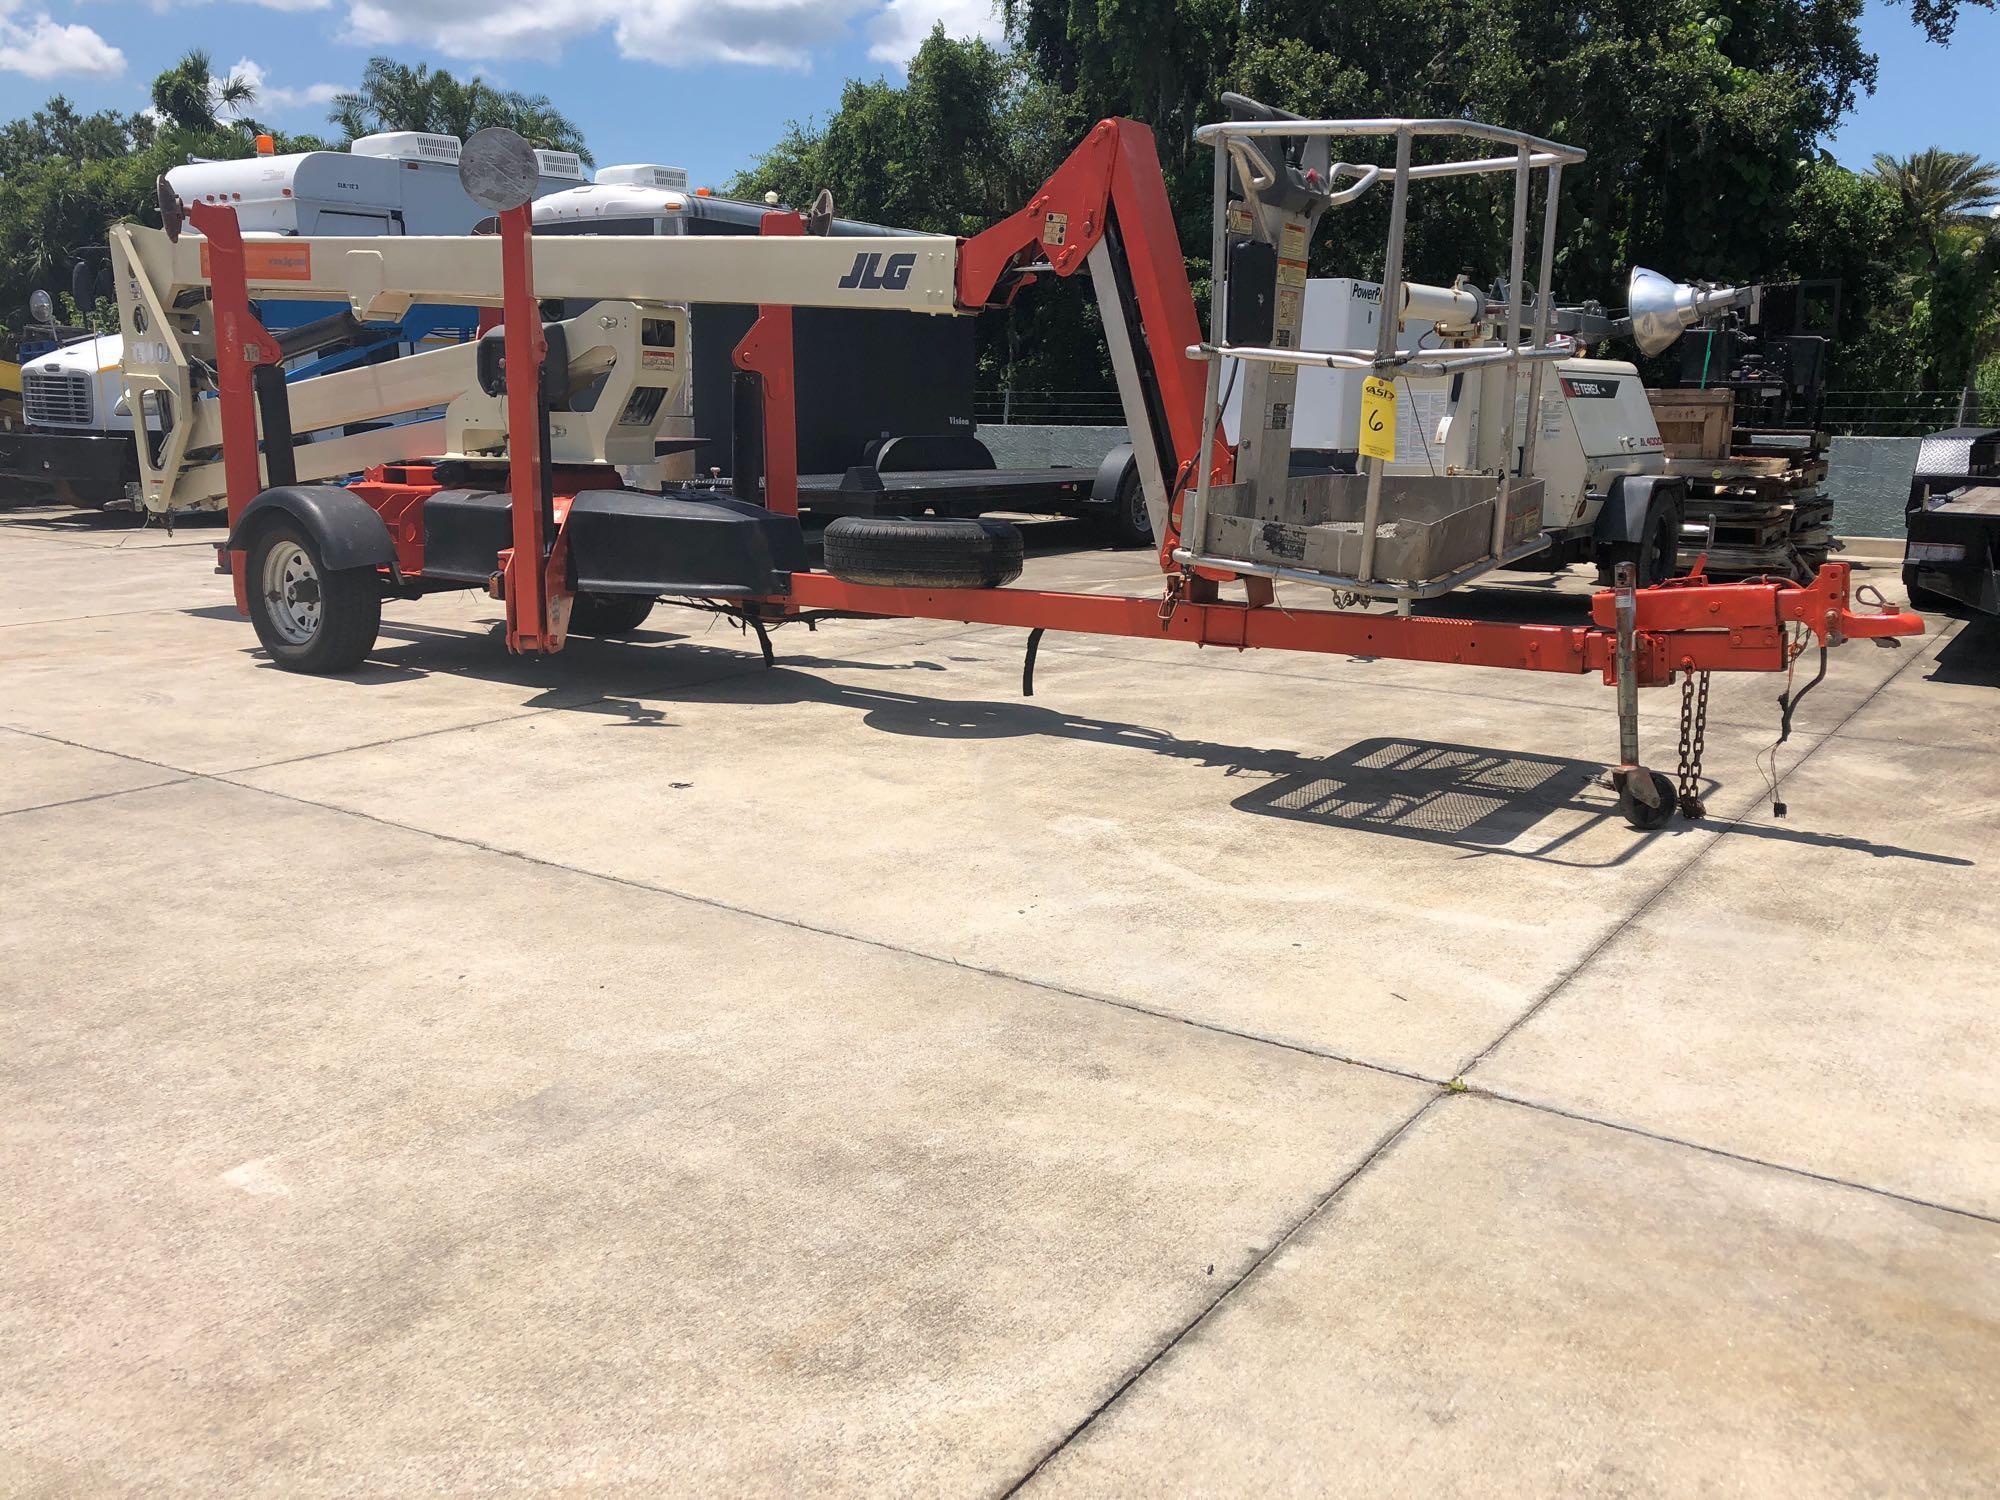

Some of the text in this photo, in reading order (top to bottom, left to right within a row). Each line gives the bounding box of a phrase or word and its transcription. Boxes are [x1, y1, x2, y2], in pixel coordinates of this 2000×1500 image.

[837, 252, 918, 291] JLG
[1352, 283, 1381, 301] PowerP
[1579, 383, 1601, 395] TEREX
[949, 416, 969, 425] Vision
[1369, 409, 1383, 431] 6
